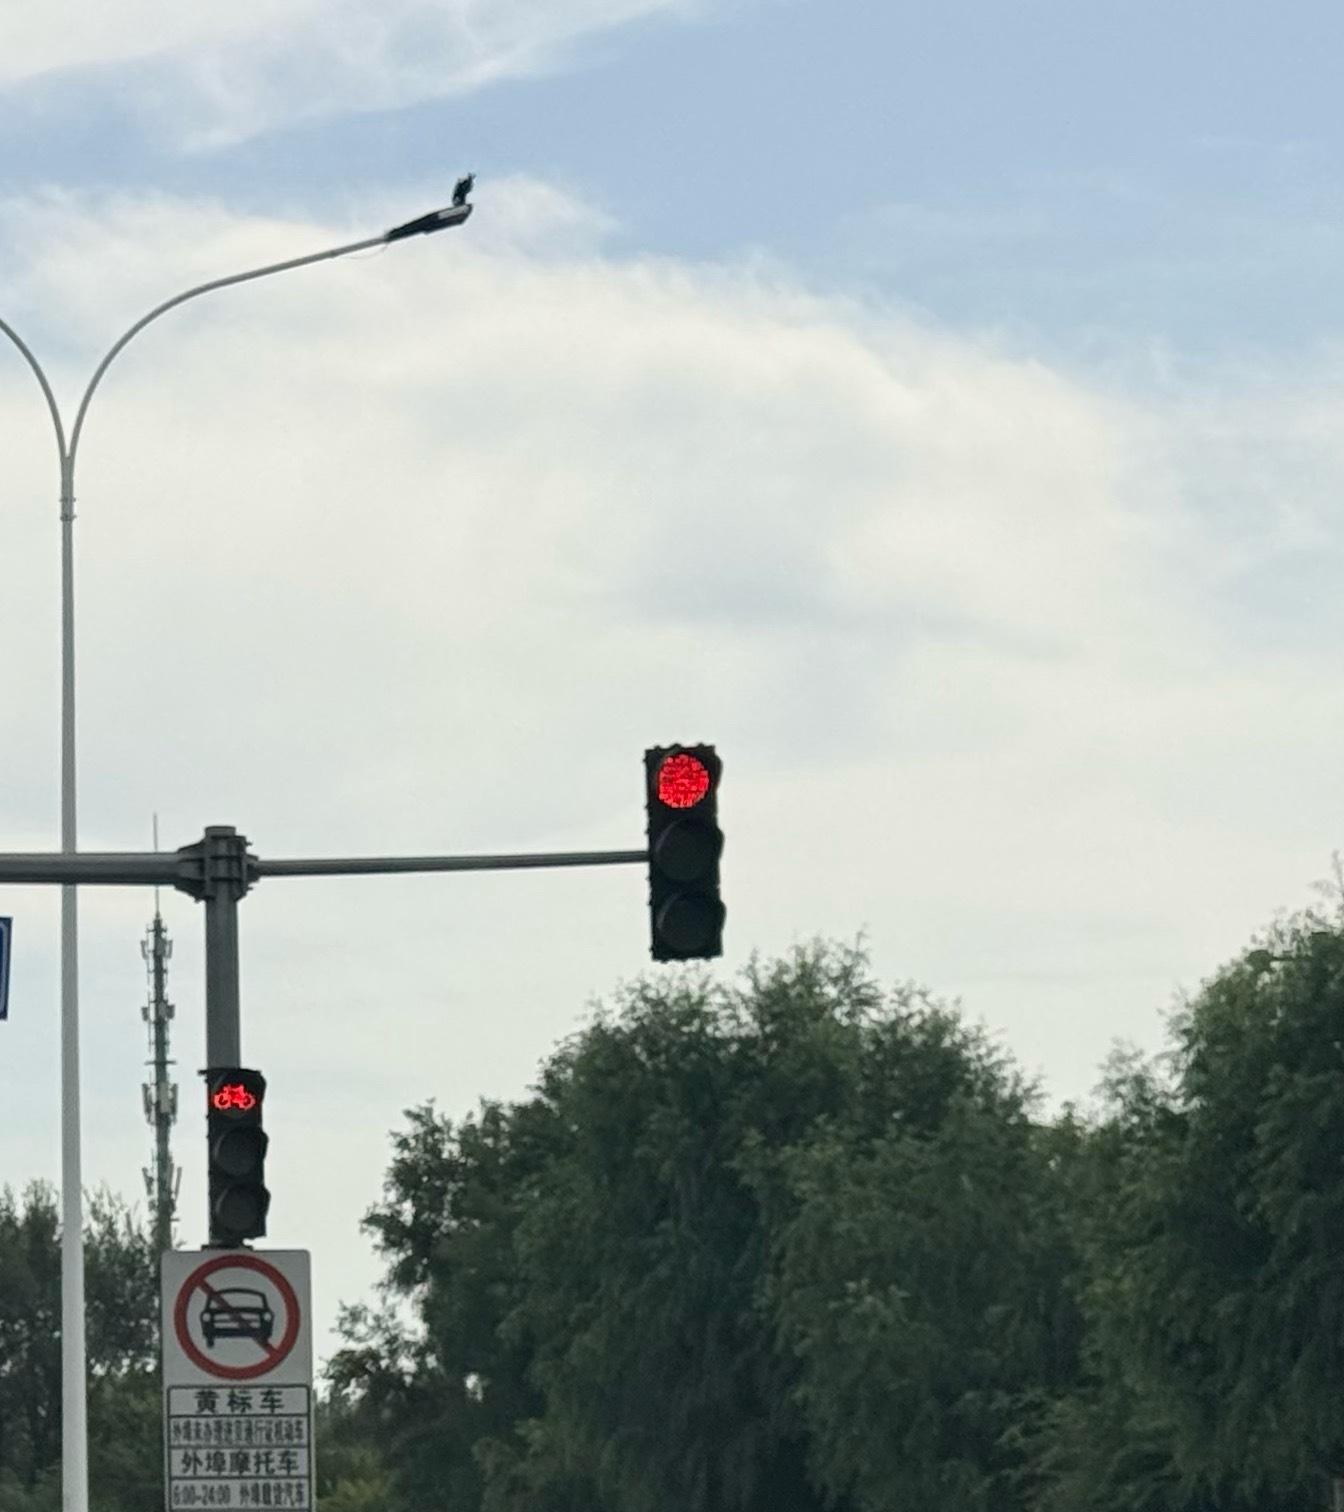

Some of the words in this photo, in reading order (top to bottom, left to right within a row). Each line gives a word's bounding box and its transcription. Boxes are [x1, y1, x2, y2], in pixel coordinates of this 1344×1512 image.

[194, 1390, 285, 1414] 黄标车
[181, 1452, 299, 1476] 外埠摩托车
